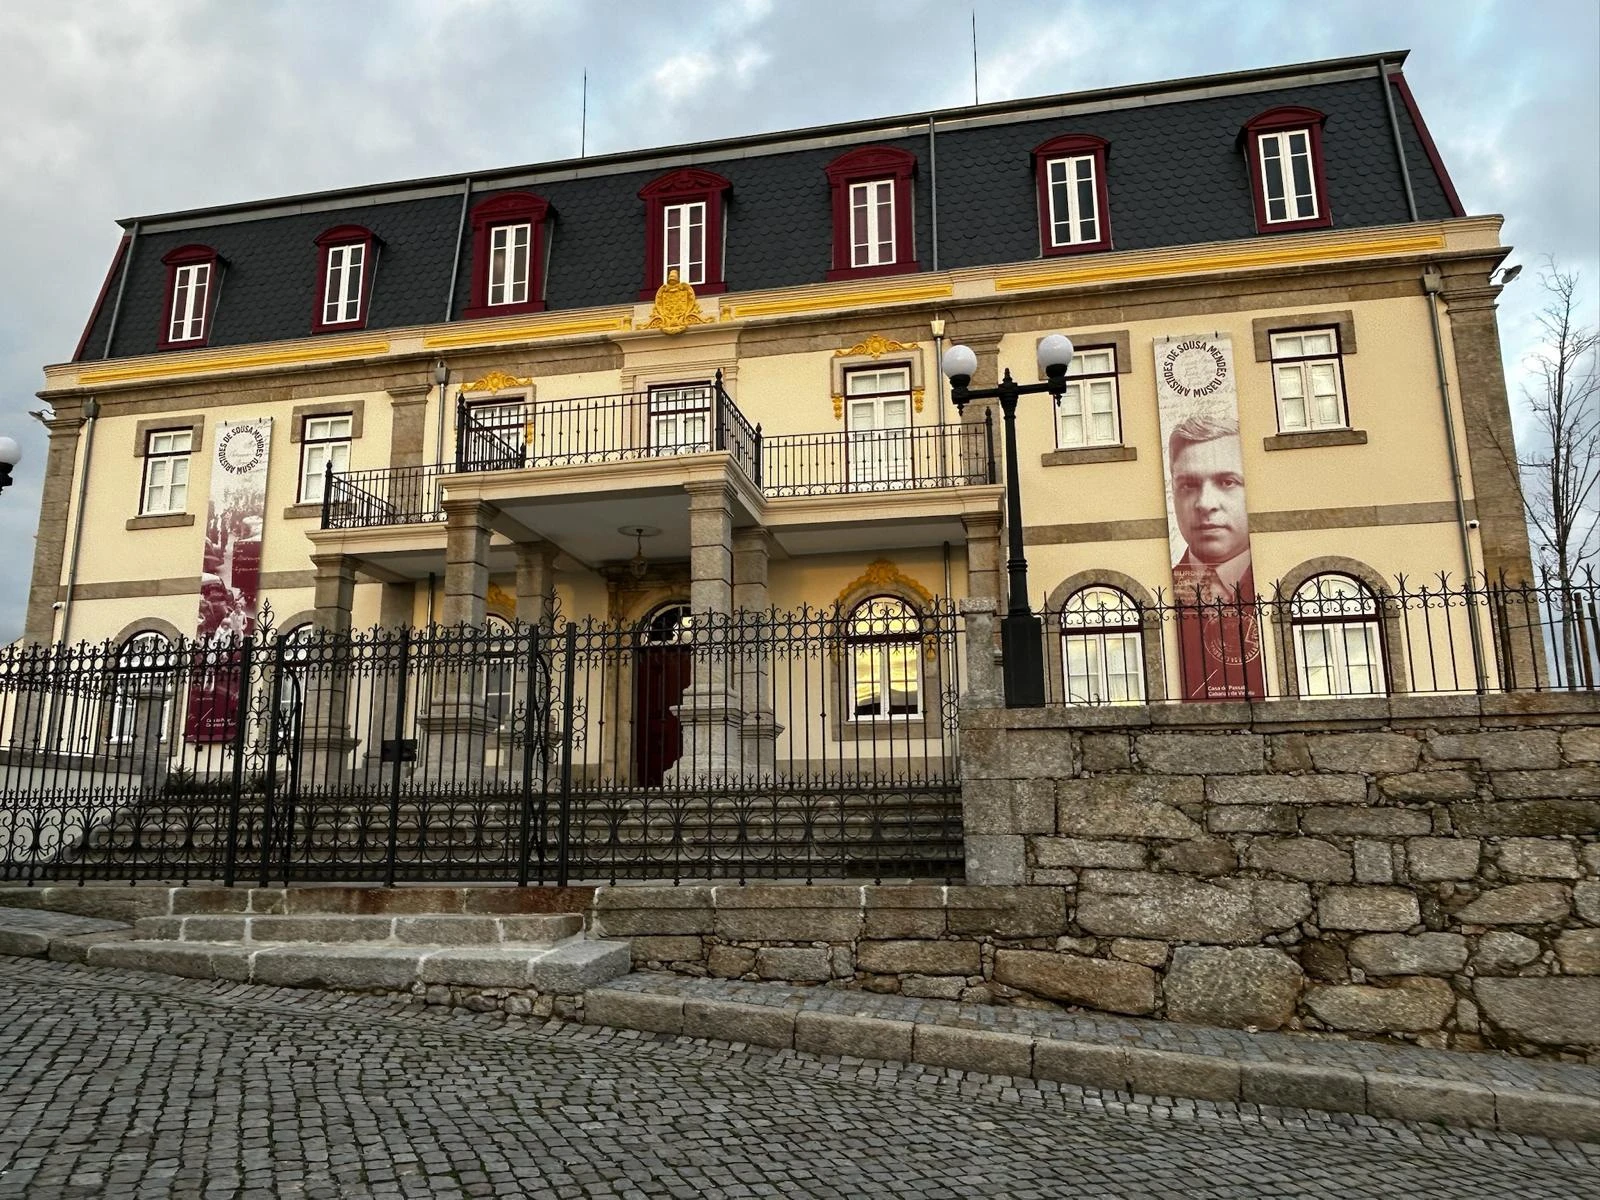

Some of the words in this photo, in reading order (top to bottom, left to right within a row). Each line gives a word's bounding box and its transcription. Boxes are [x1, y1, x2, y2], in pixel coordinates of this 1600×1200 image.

[1166, 349, 1180, 361] DE
[1176, 340, 1207, 353] SOUSA
[1206, 345, 1227, 378] MENDES
[1163, 361, 1191, 397] ARISTIDES
[1193, 378, 1222, 398] MUSEU
[222, 432, 233, 443] DE
[231, 425, 253, 436] SOUSA
[251, 429, 265, 457] MENDES
[218, 443, 236, 474] ARISTIDES
[236, 457, 259, 475] MUSEU
